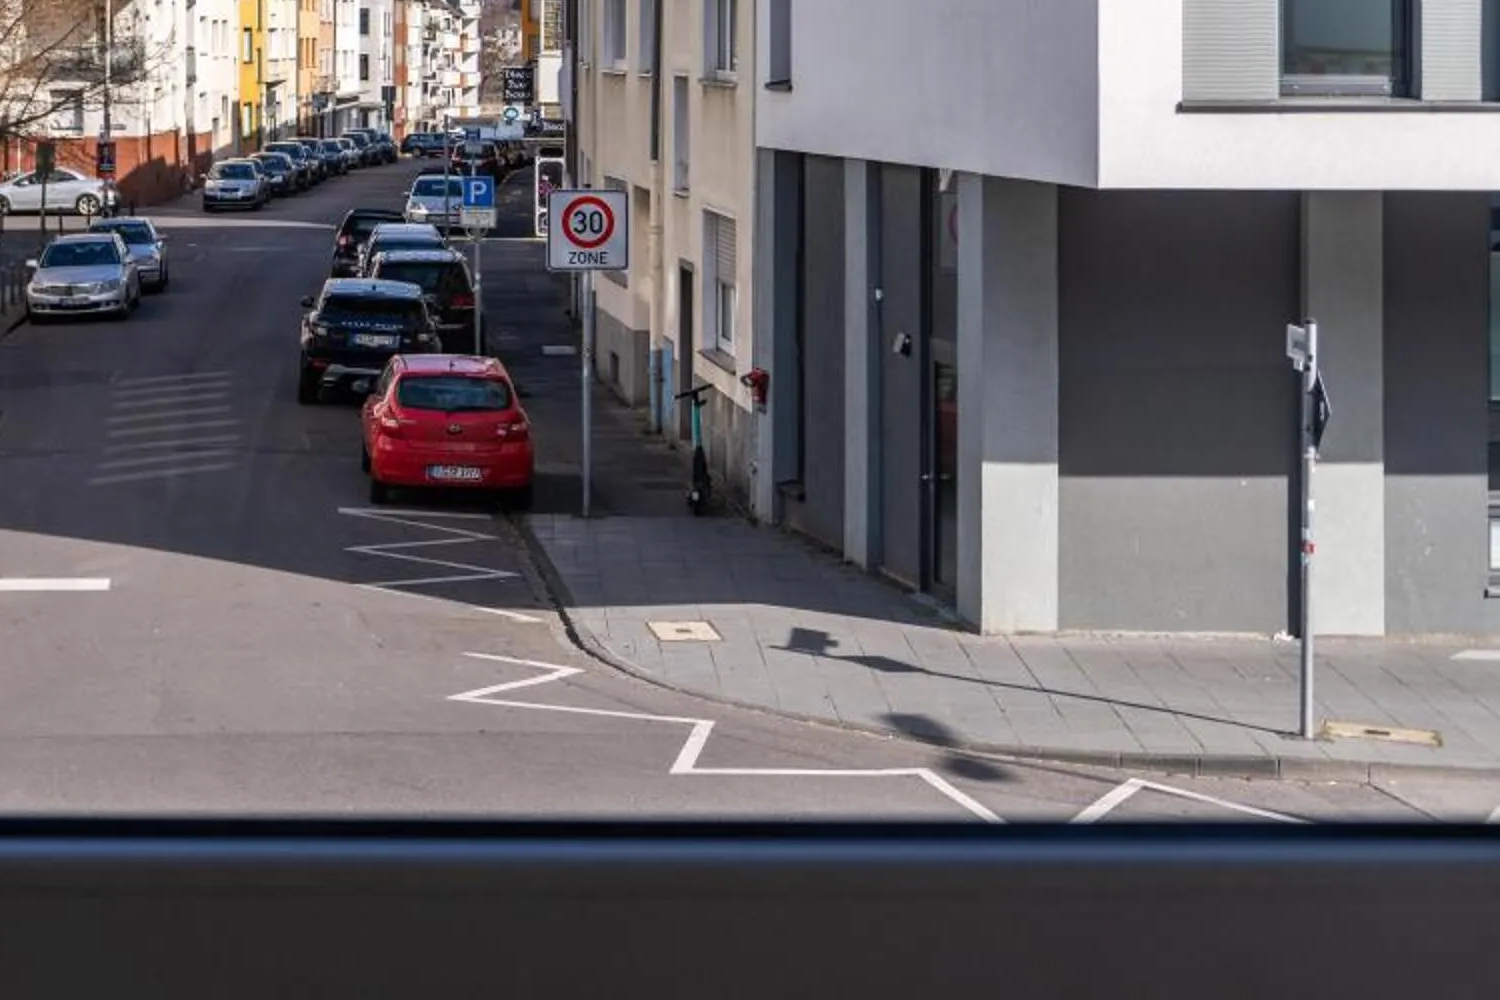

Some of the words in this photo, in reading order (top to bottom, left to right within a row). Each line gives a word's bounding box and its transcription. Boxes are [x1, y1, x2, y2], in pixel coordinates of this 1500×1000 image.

[470, 181, 487, 204] P
[573, 210, 604, 234] 30
[568, 251, 609, 265] ZONE
